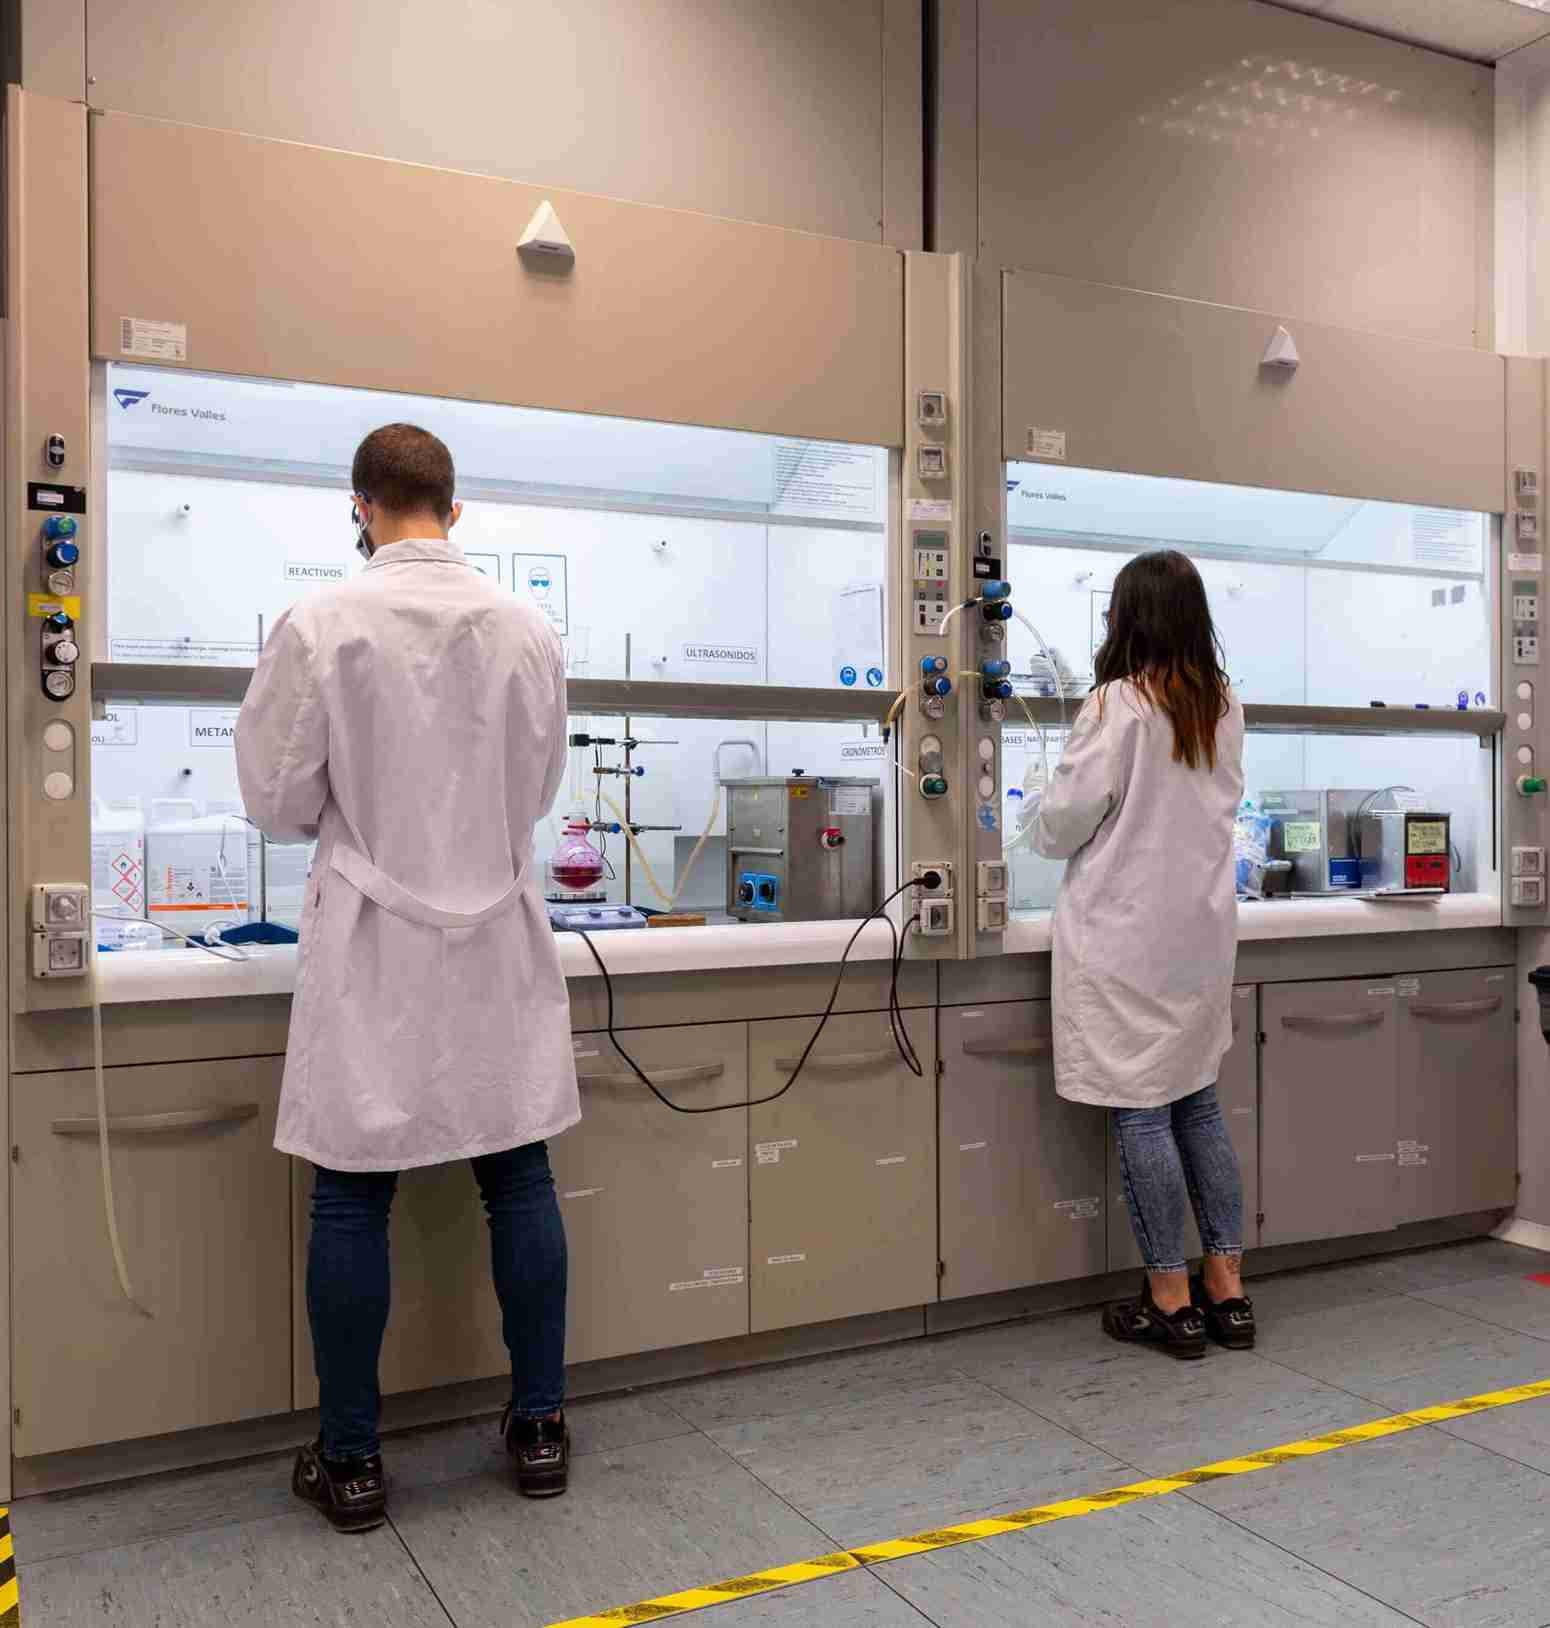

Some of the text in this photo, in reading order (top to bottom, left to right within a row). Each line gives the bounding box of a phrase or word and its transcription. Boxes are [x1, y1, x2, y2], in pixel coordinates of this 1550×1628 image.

[151, 403, 227, 421] Flores Valles
[288, 567, 343, 578] REACTIVOS
[686, 647, 756, 661] ULTRASONIDOS
